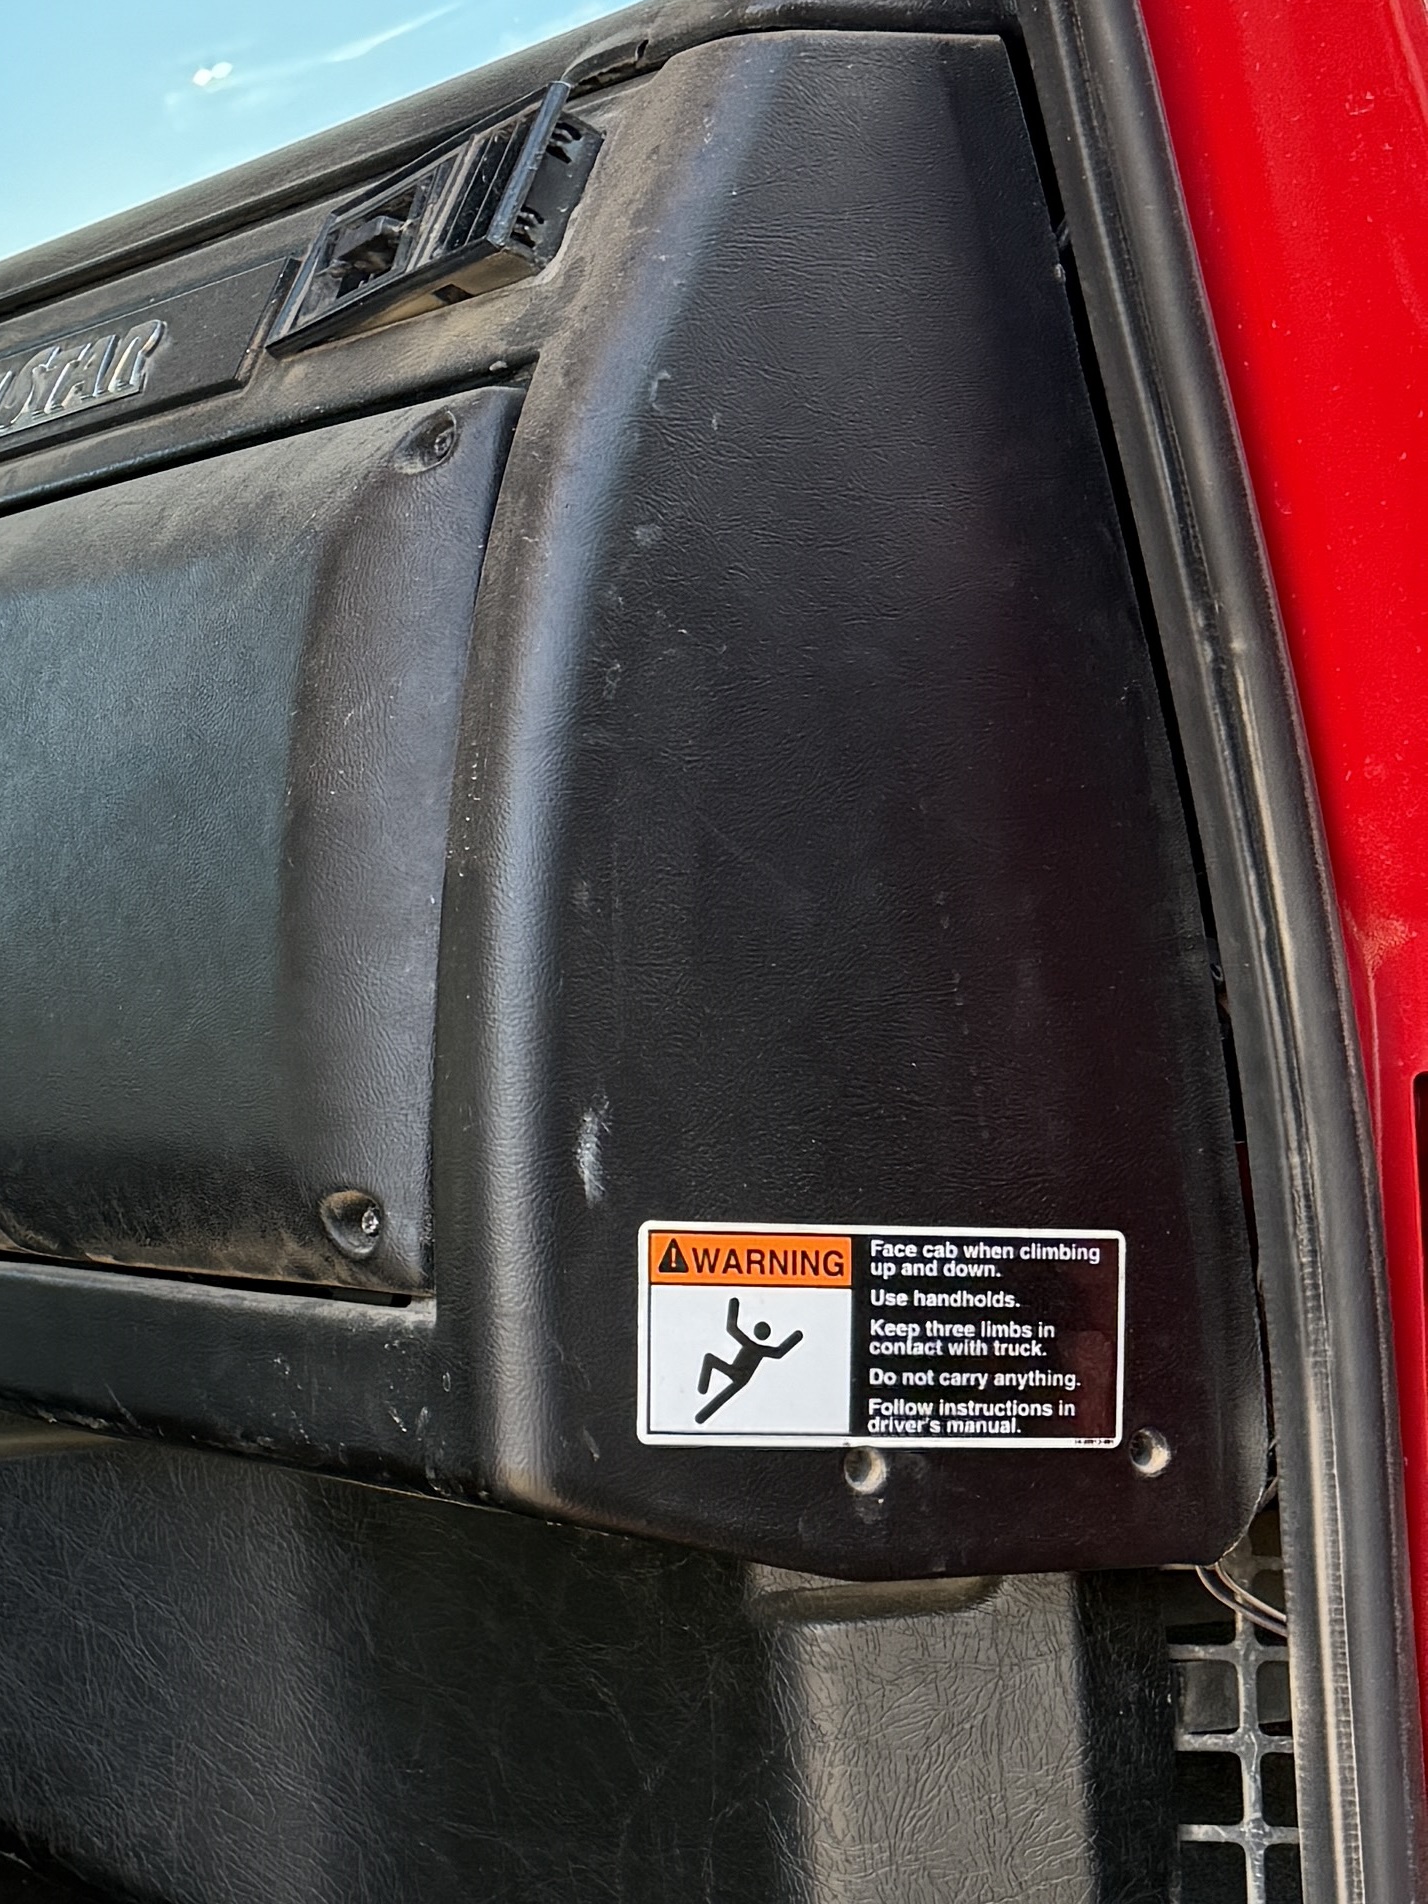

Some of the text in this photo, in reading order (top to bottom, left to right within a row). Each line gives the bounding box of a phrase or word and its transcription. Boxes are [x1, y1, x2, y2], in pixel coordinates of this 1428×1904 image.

[870, 1239, 1101, 1265] Face cab when climbing
[691, 1248, 845, 1278] WARNING
[870, 1260, 1002, 1280] up and down.
[870, 1289, 1021, 1308] Use handholds.
[870, 1318, 1055, 1343] Keep three limbs in
[869, 1338, 1047, 1357] contact with truck.
[869, 1368, 1082, 1390] Do not carry anything.
[868, 1398, 1076, 1417] Follow instructions in
[867, 1416, 1022, 1434] driver's manual.
